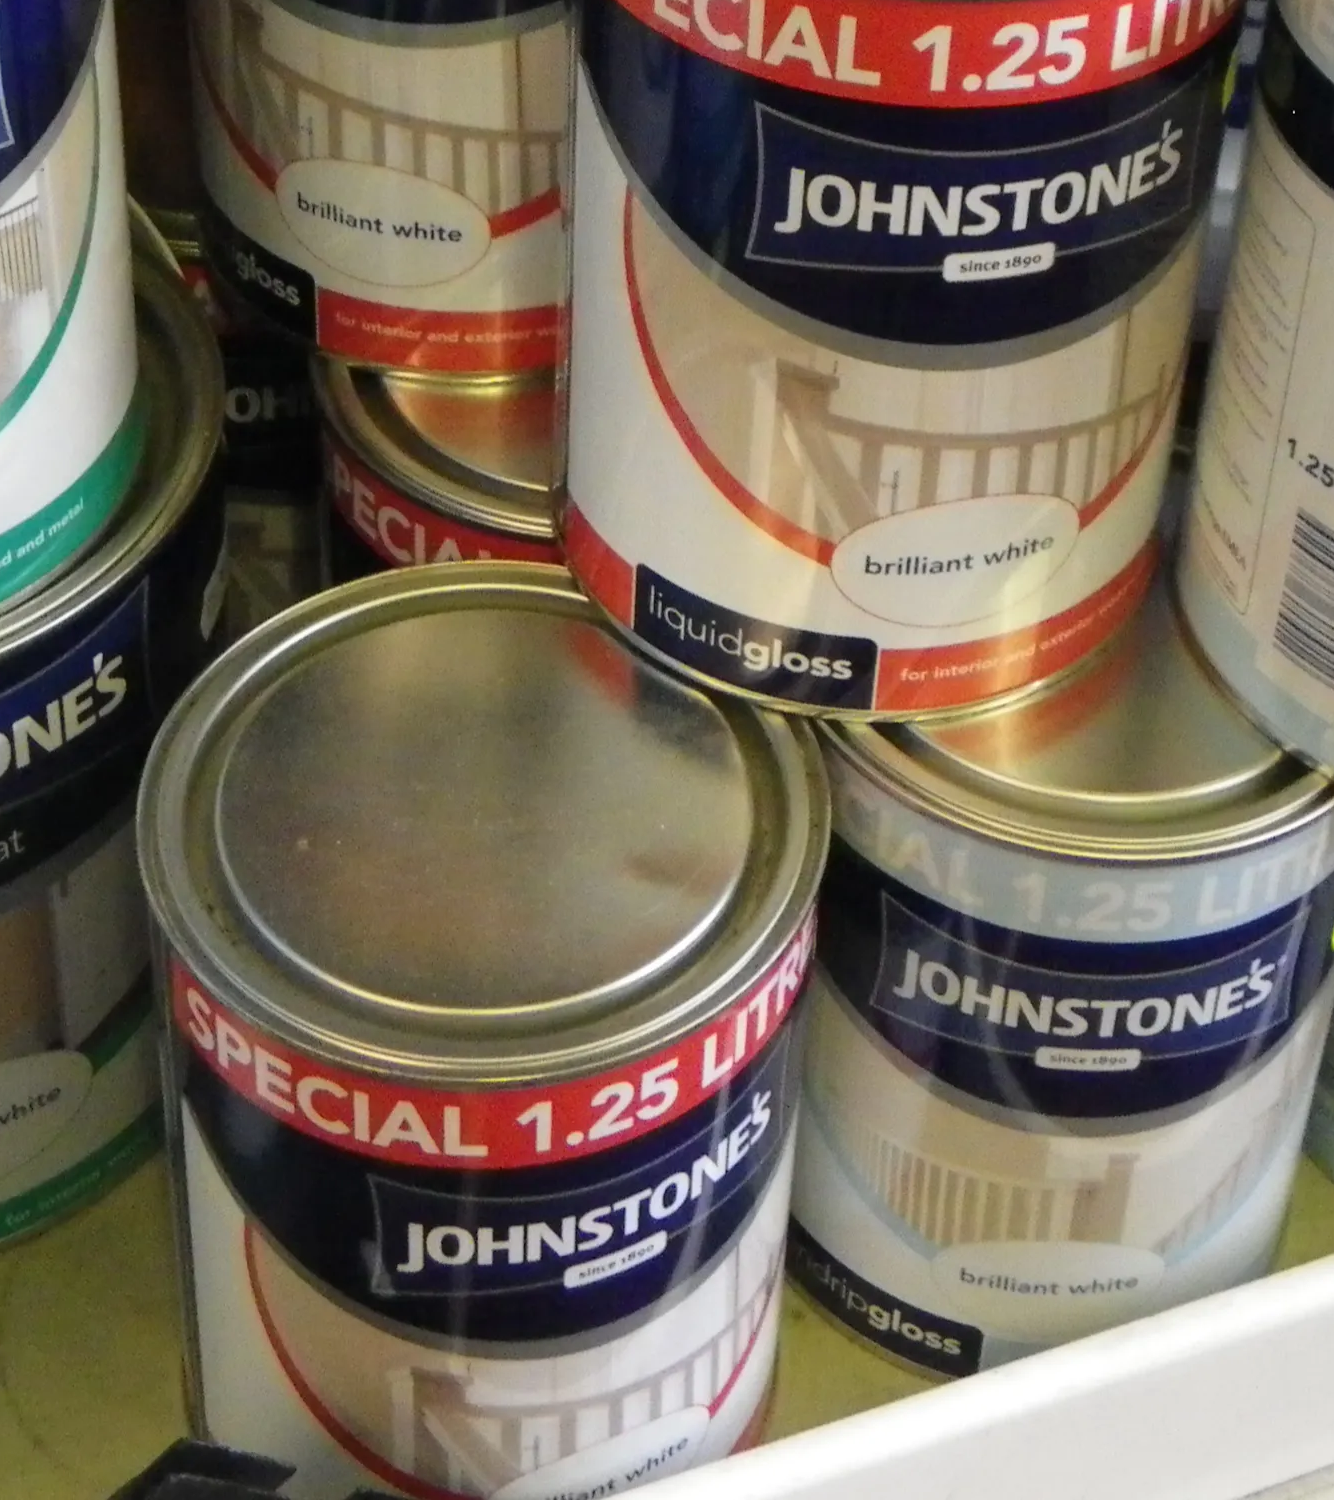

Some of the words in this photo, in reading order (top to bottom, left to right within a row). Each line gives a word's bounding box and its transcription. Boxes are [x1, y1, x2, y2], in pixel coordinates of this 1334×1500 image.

[912, 16, 1087, 93] 1.25
[773, 120, 1184, 238] JOHNSTONE'S
[295, 190, 385, 235] brilliant
[389, 222, 464, 245] white
[959, 257, 1002, 275] since
[1004, 250, 1043, 273] 1890
[361, 318, 422, 341] interior
[427, 329, 460, 344] and
[464, 328, 533, 345] exterior
[16, 533, 47, 562] and
[48, 498, 85, 540] metal
[862, 550, 975, 578] brilliant
[983, 531, 1056, 568] white
[647, 584, 855, 681] liquidgloss
[899, 667, 929, 682] for
[933, 656, 1000, 680] interior
[1010, 871, 1174, 932] 1.25
[892, 948, 1275, 1038] JOHNSTONE'S
[186, 989, 489, 1158] SPECIAL
[515, 1057, 679, 1154] 1.25
[1048, 1052, 1086, 1067] since
[397, 1088, 772, 1274] JOHNSTONE'S
[577, 1260, 617, 1280] since
[618, 1242, 656, 1265] 1890
[959, 1266, 1061, 1297] brilliant
[1069, 1274, 1140, 1297] white
[624, 1435, 689, 1483] white
